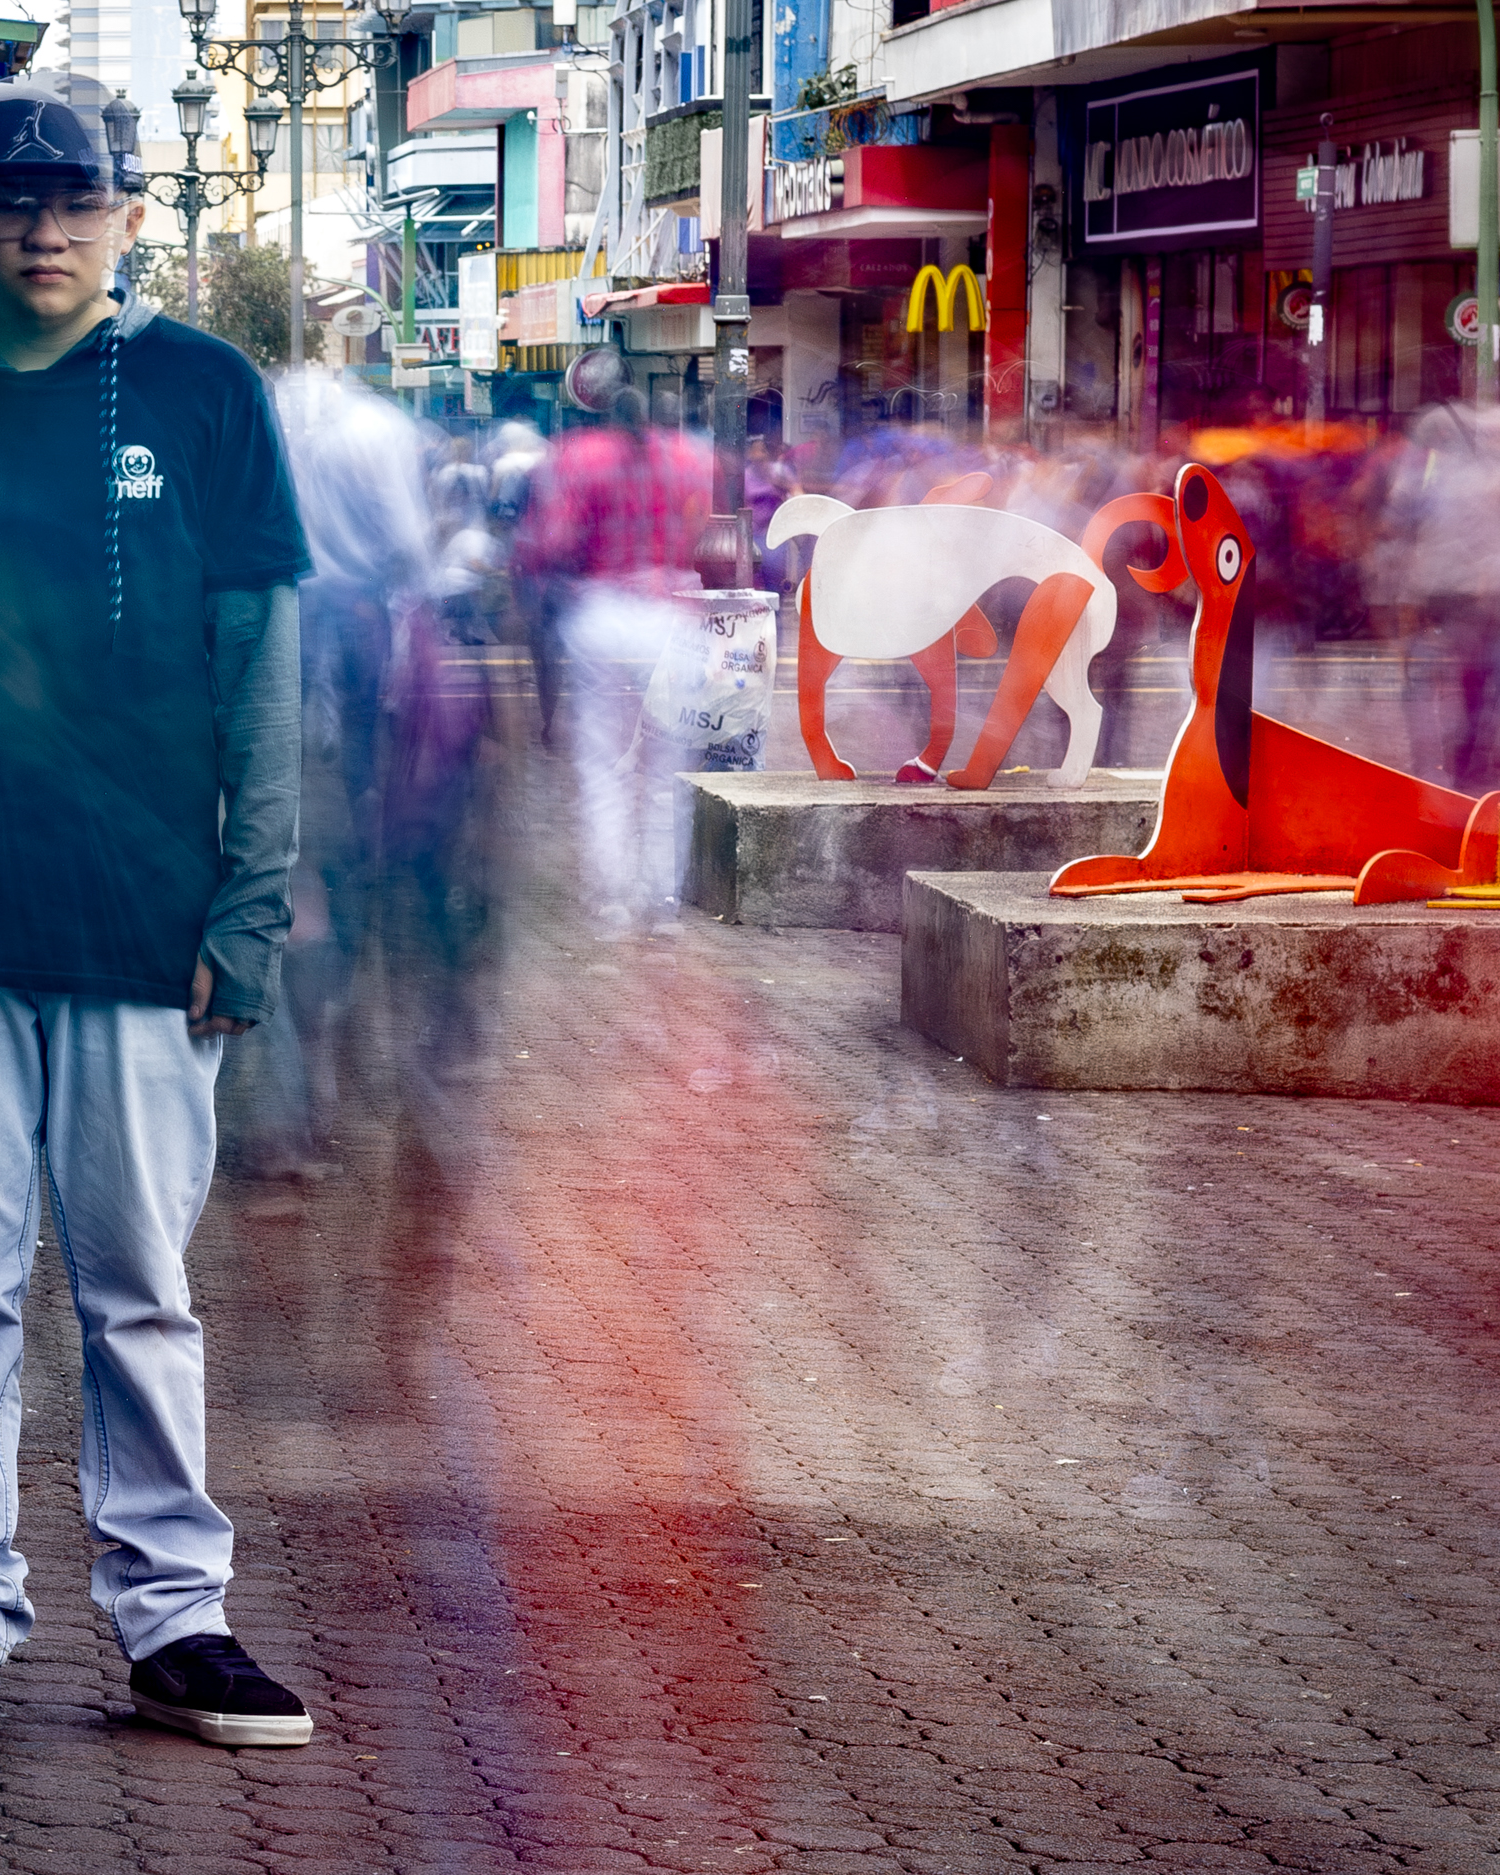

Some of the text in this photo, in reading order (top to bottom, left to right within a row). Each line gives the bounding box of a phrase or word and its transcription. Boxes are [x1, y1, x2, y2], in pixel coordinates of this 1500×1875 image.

[118, 475, 163, 499] neff
[724, 651, 750, 661] BOLSA
[679, 706, 724, 731] MSJ
[708, 742, 736, 754] BOLSA
[705, 752, 754, 766] ORGANICA
